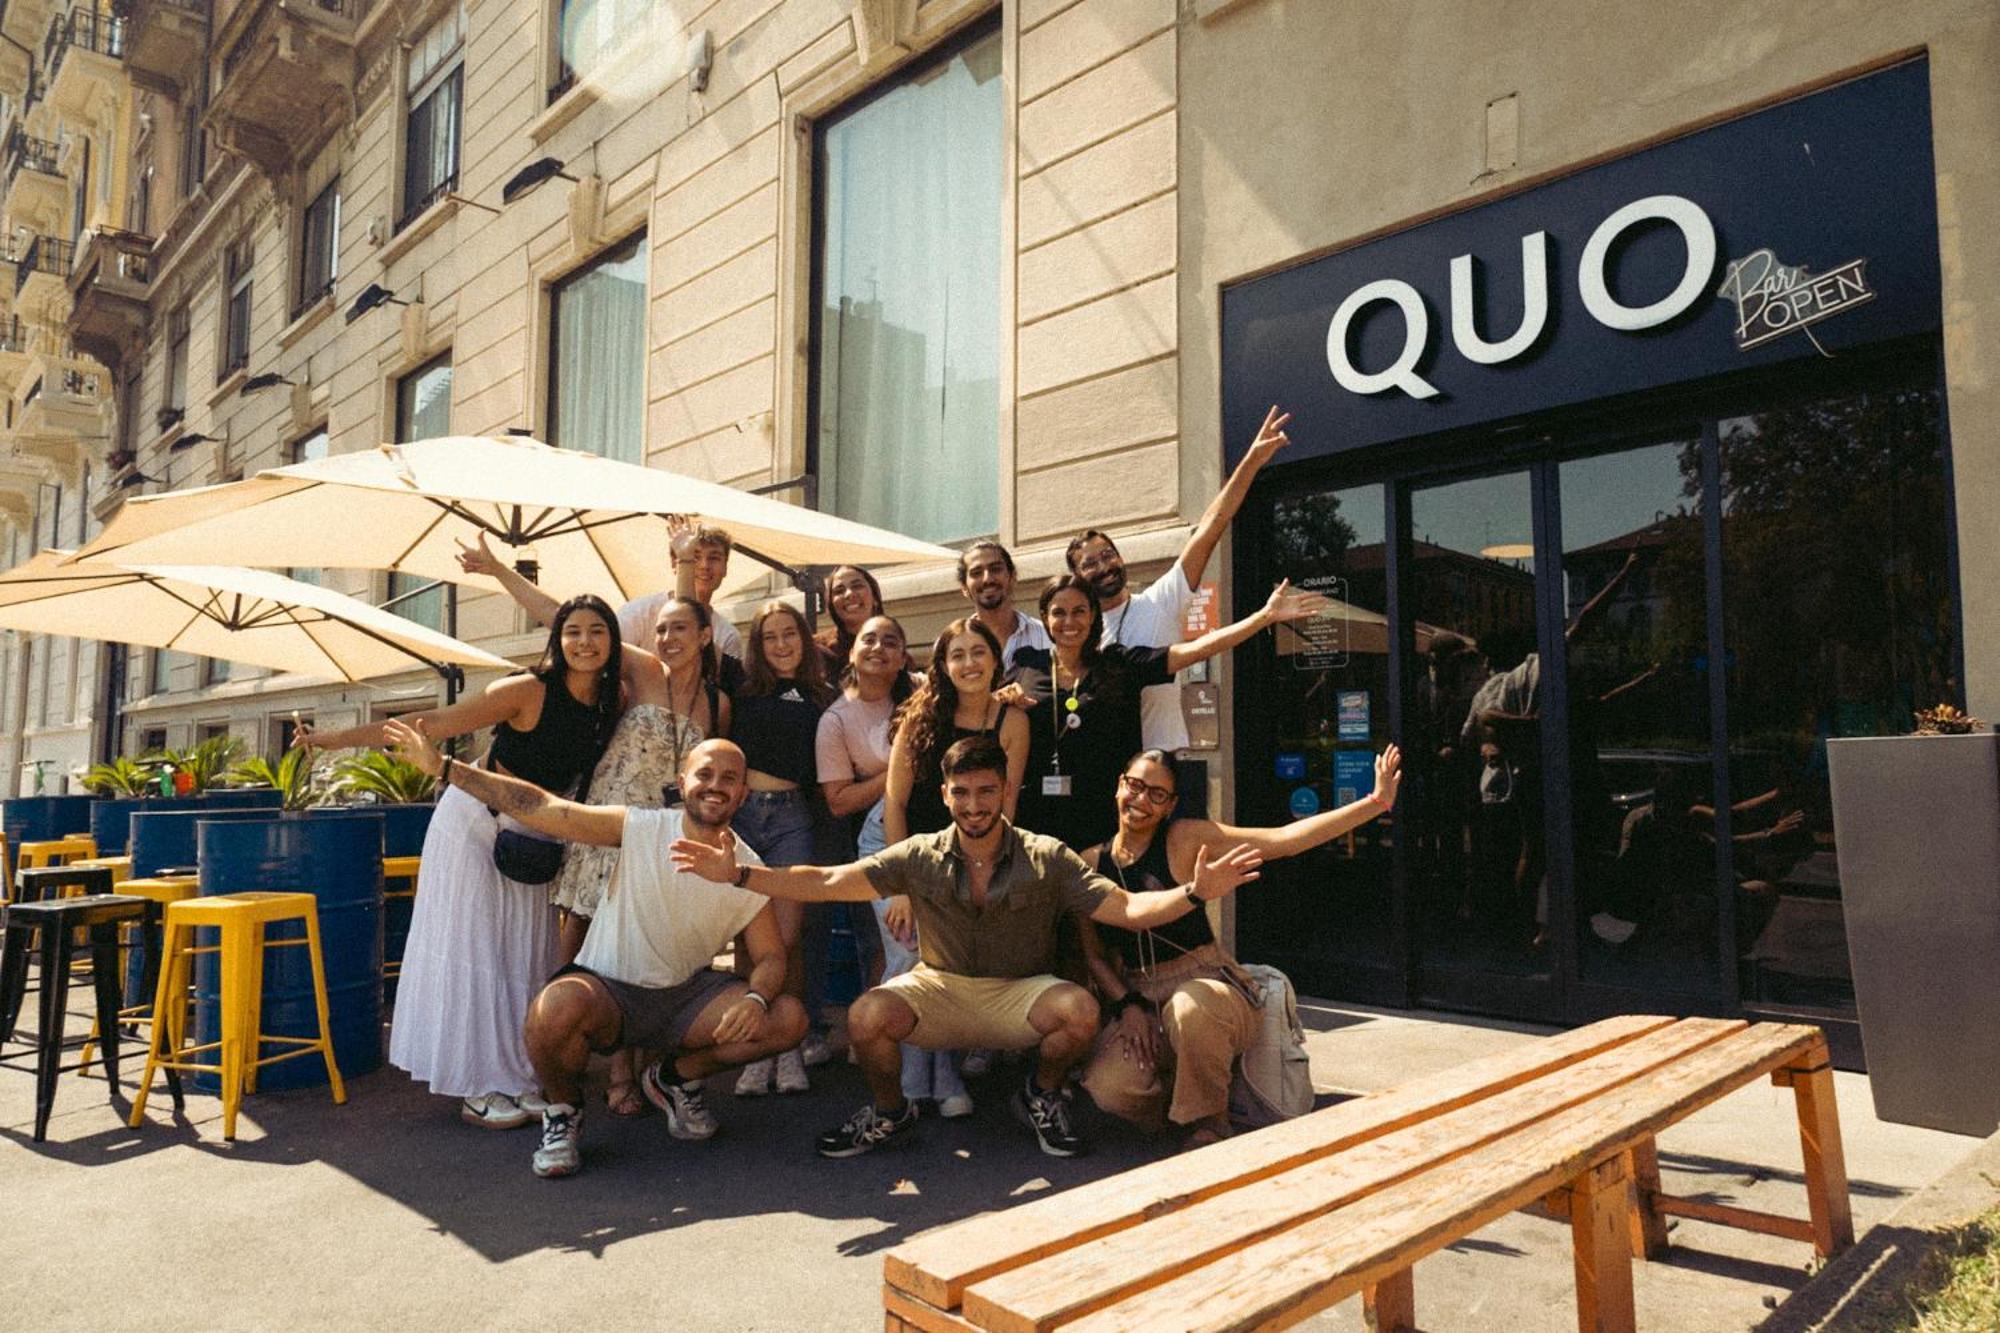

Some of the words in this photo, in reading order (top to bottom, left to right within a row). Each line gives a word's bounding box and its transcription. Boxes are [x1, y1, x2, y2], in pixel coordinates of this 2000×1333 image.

[1327, 195, 1717, 399] QUO
[1720, 250, 1797, 338] Bar
[1763, 267, 1866, 328] OPEN
[1303, 575, 1337, 588] ORARIO
